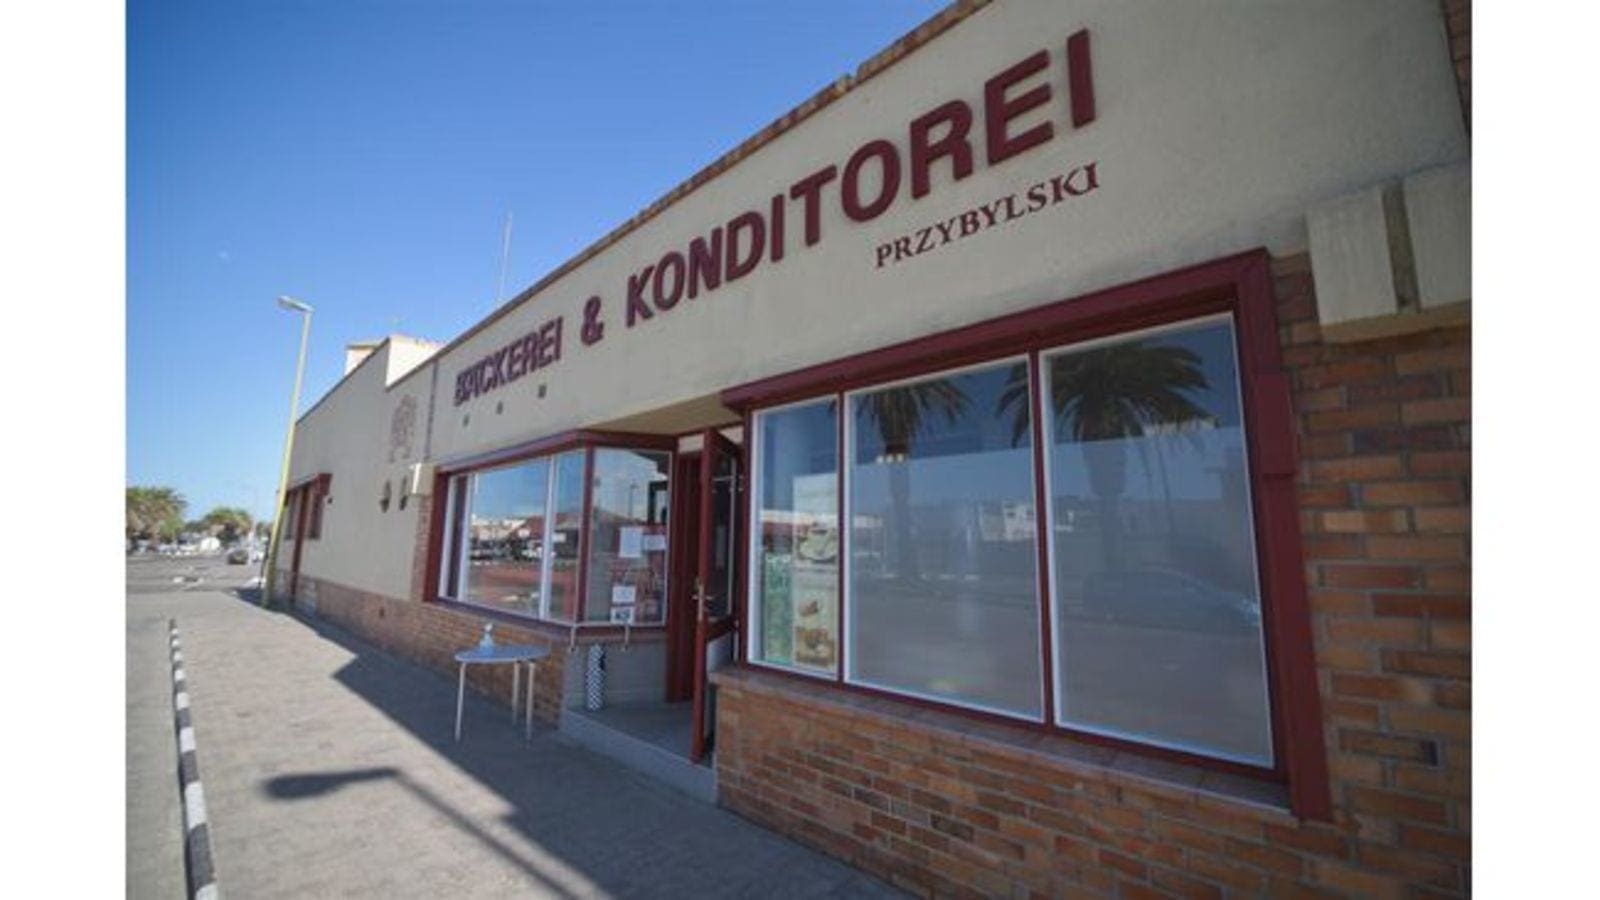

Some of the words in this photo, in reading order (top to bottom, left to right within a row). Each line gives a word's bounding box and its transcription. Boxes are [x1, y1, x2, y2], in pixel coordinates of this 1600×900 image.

[580, 295, 605, 347] &
[626, 28, 1098, 329] KONDITOREI
[876, 162, 1100, 269] PRZYBYLSKI
